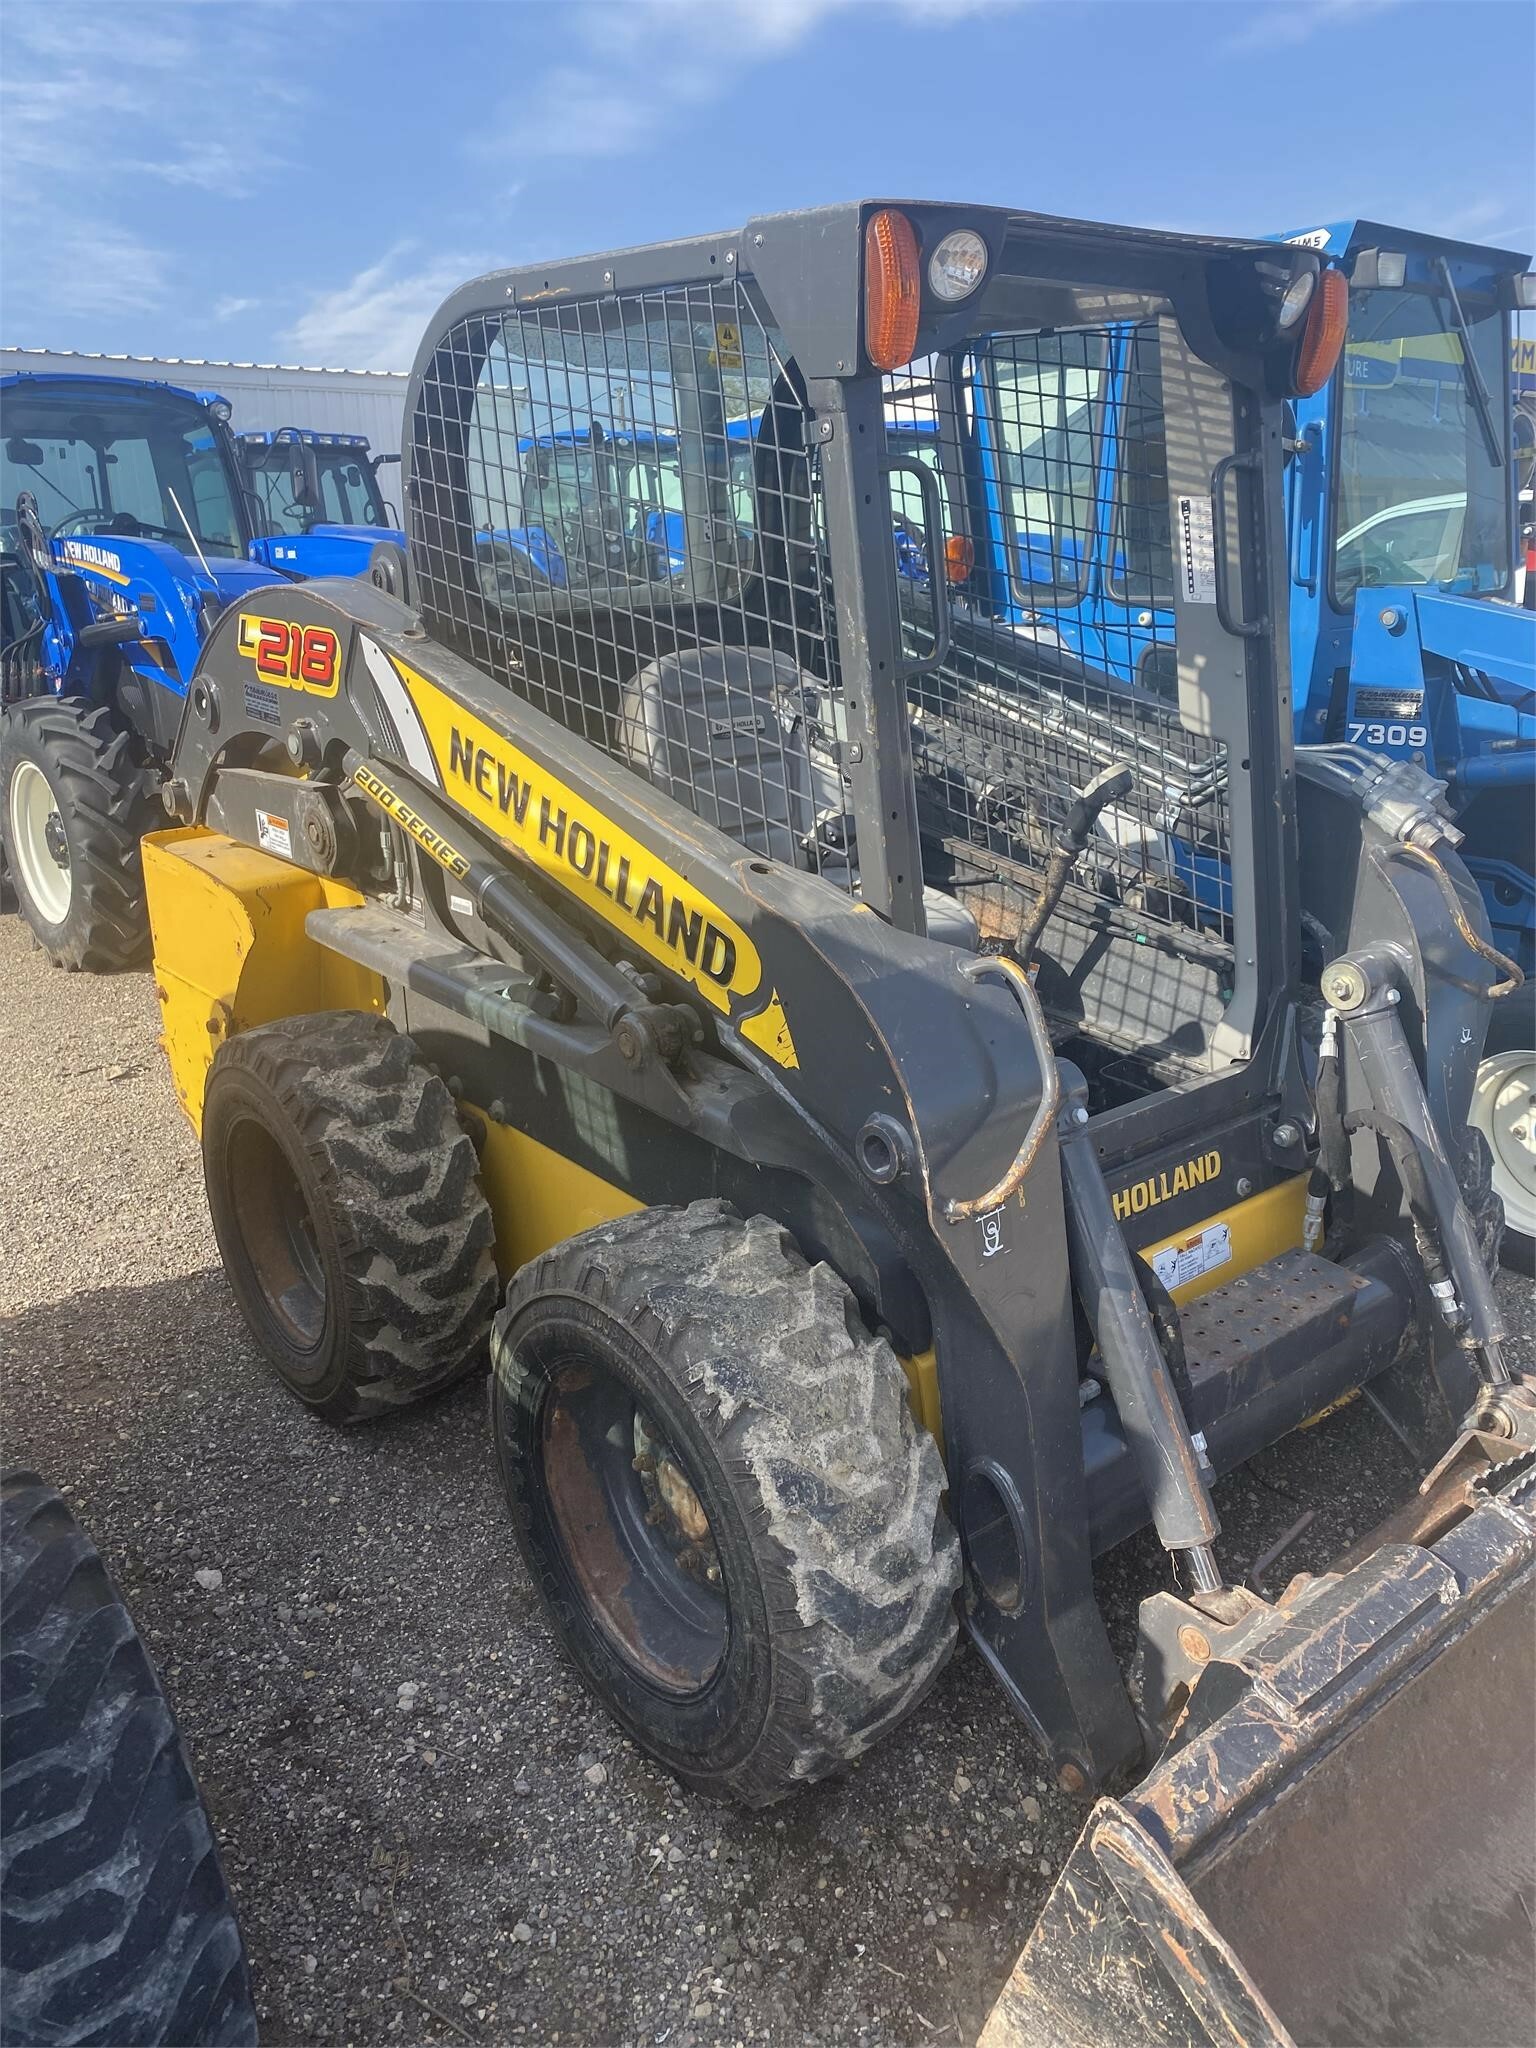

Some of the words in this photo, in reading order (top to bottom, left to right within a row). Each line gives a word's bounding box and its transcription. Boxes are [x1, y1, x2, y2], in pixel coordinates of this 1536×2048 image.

[82, 543, 120, 572] HOLLAND
[239, 618, 338, 689] L218
[736, 719, 761, 728] HOLLAD
[1348, 723, 1427, 747] 7309
[354, 767, 397, 808] 200
[394, 804, 470, 876] SERIES
[450, 725, 532, 826] NEW
[539, 794, 738, 988] HOLLAND
[1111, 1150, 1222, 1222] HOLLAND
